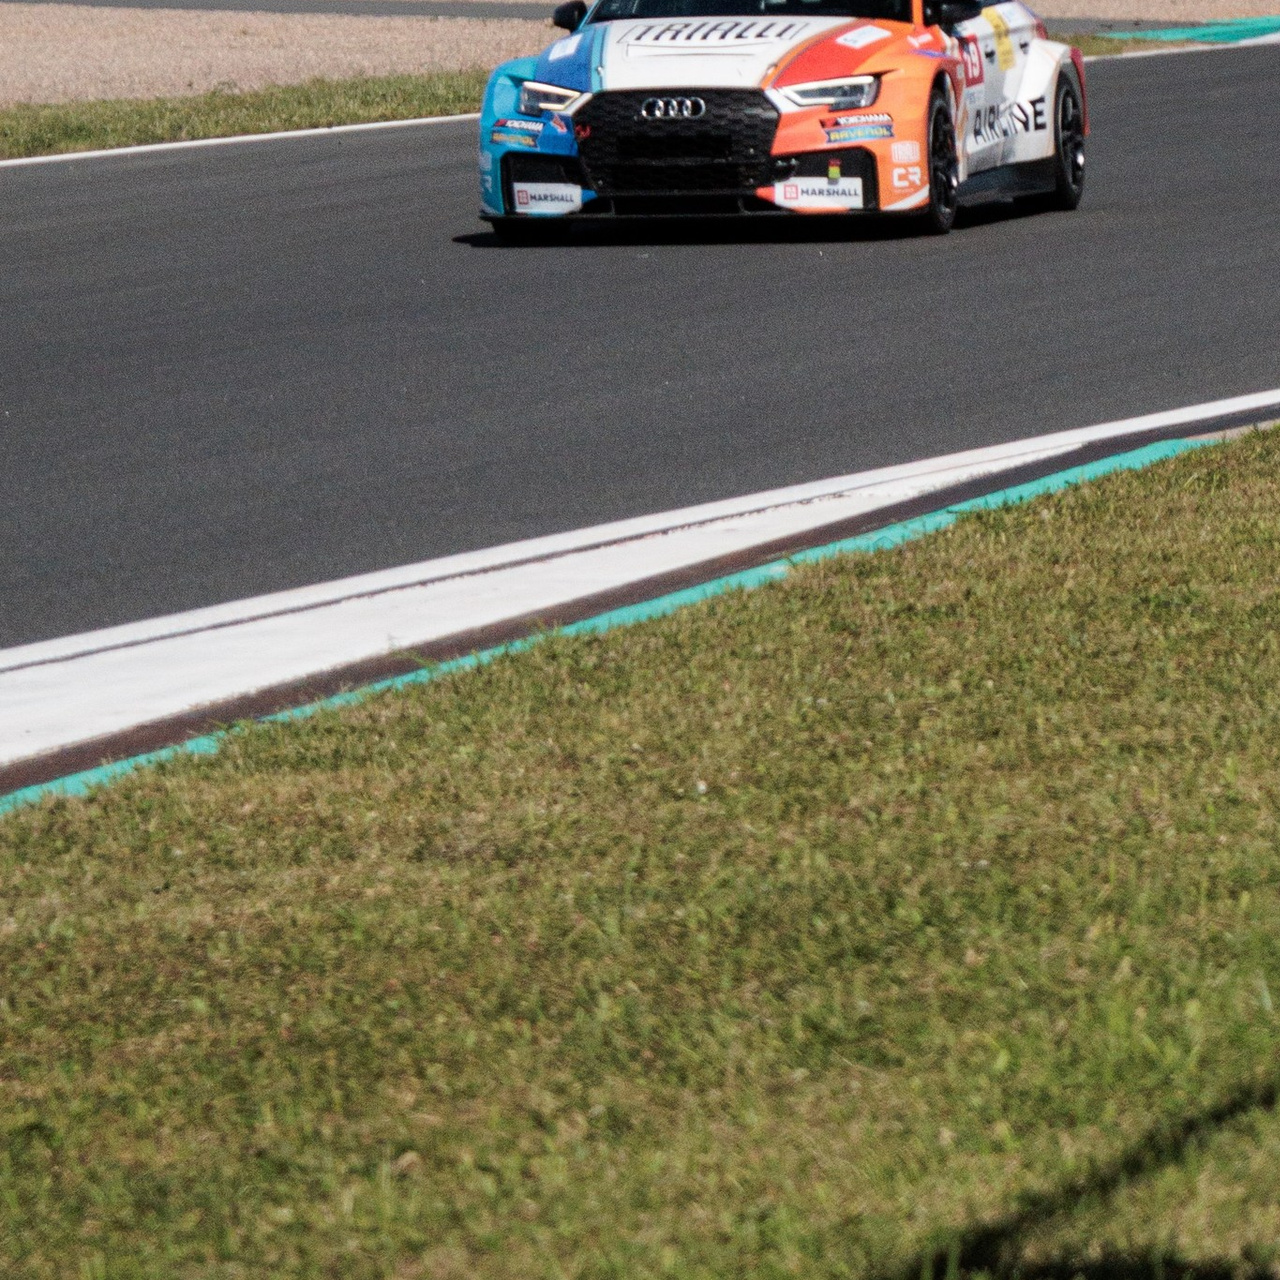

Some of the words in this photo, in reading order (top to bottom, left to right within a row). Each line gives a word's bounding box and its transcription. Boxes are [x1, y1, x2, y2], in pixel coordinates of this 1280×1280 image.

[632, 21, 796, 41] TRIALLI
[963, 41, 981, 79] 19
[529, 193, 575, 203] MARSHALL
[800, 187, 860, 198] MARSHALL
